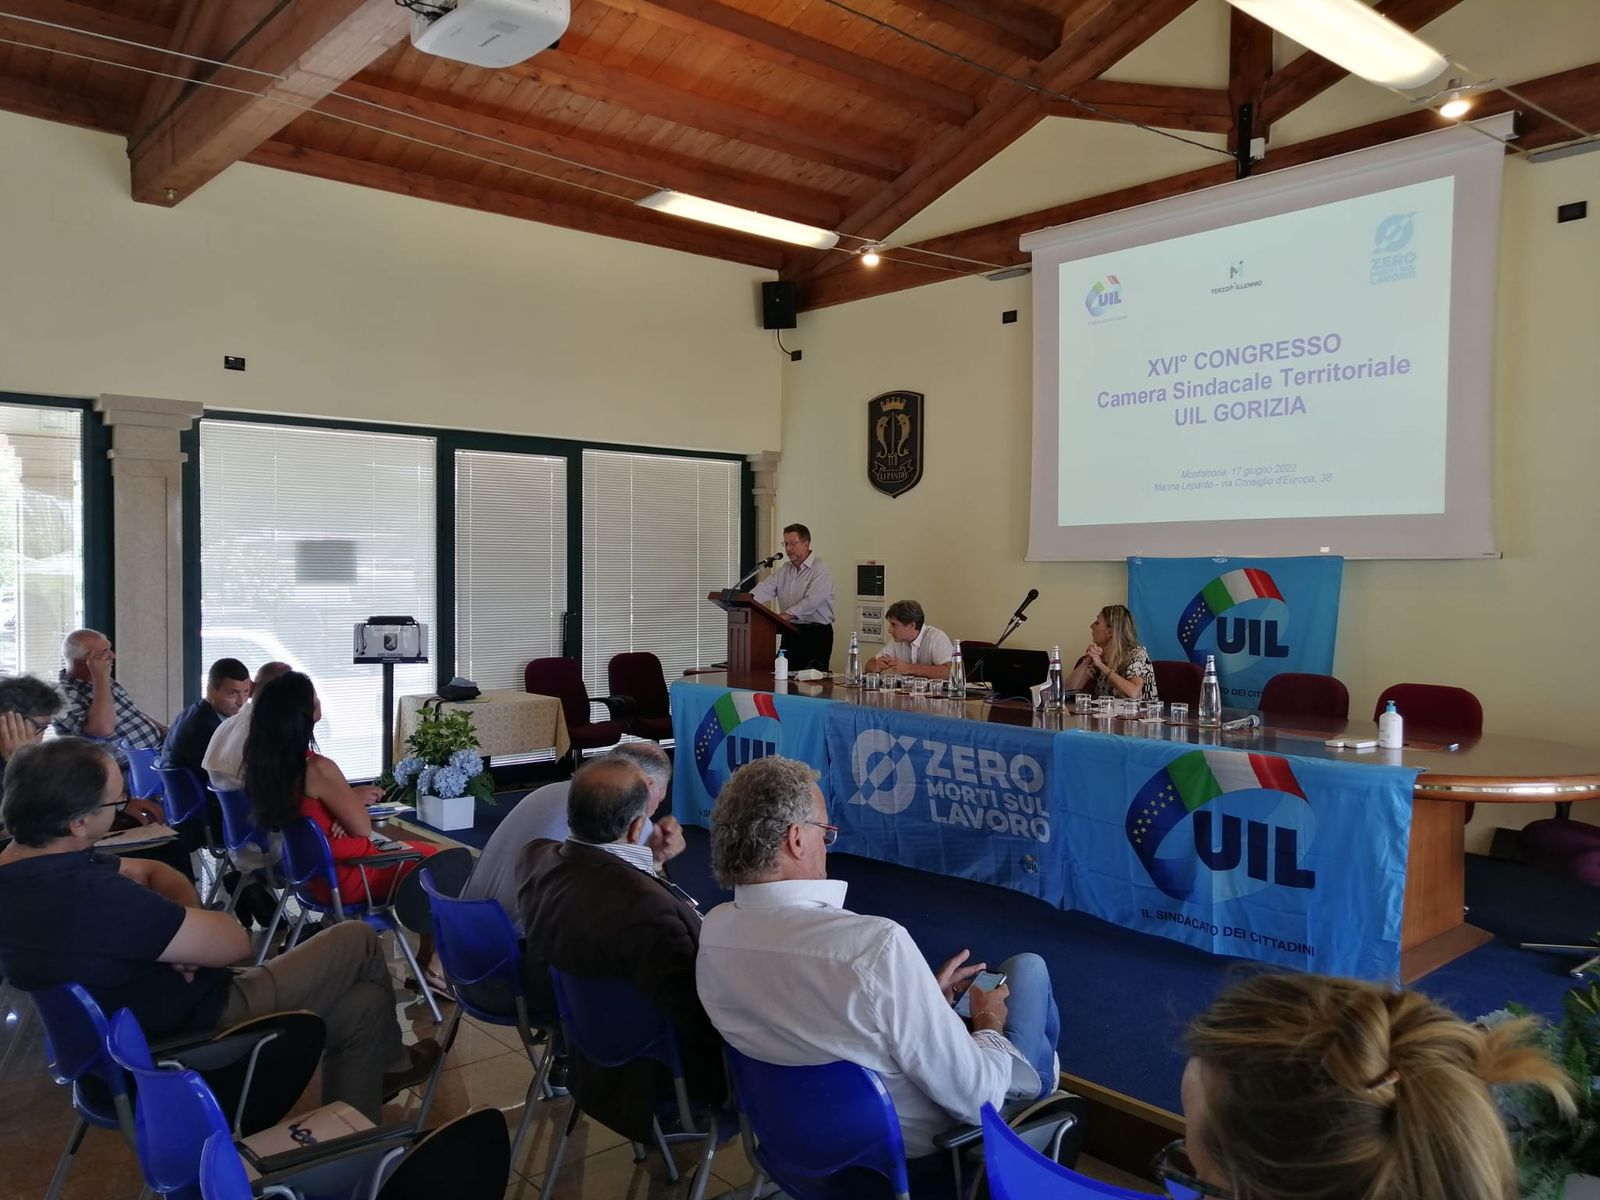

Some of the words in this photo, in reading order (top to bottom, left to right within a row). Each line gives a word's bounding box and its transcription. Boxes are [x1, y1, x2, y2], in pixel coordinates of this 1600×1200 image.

[1098, 290, 1122, 307] UIL
[1147, 354, 1187, 378] XVI°
[1194, 332, 1342, 371] CONGRESSO
[1097, 384, 1167, 409] Camera
[1172, 371, 1273, 401] Sindacale
[1279, 354, 1412, 388] Territoriale
[1174, 406, 1208, 427] UIL
[1213, 395, 1308, 423] GORIZIA
[1181, 480, 1214, 493] Lepanto
[1235, 477, 1274, 490] Consiglio
[1320, 472, 1333, 484] 38
[1232, 466, 1242, 476] 17
[1243, 464, 1273, 479] giugno
[1275, 462, 1298, 475] 2022
[1216, 616, 1289, 658] UIL
[922, 739, 1045, 794] ZERO
[925, 779, 999, 809] MORTI
[1004, 792, 1051, 818] SUL
[929, 799, 1051, 844] LAVORO
[1193, 810, 1315, 890] UIL
[1141, 908, 1153, 919] IL
[1156, 910, 1219, 936] SINDACATO
[1223, 926, 1246, 940] DEI
[1250, 932, 1315, 957] CITTADINI
